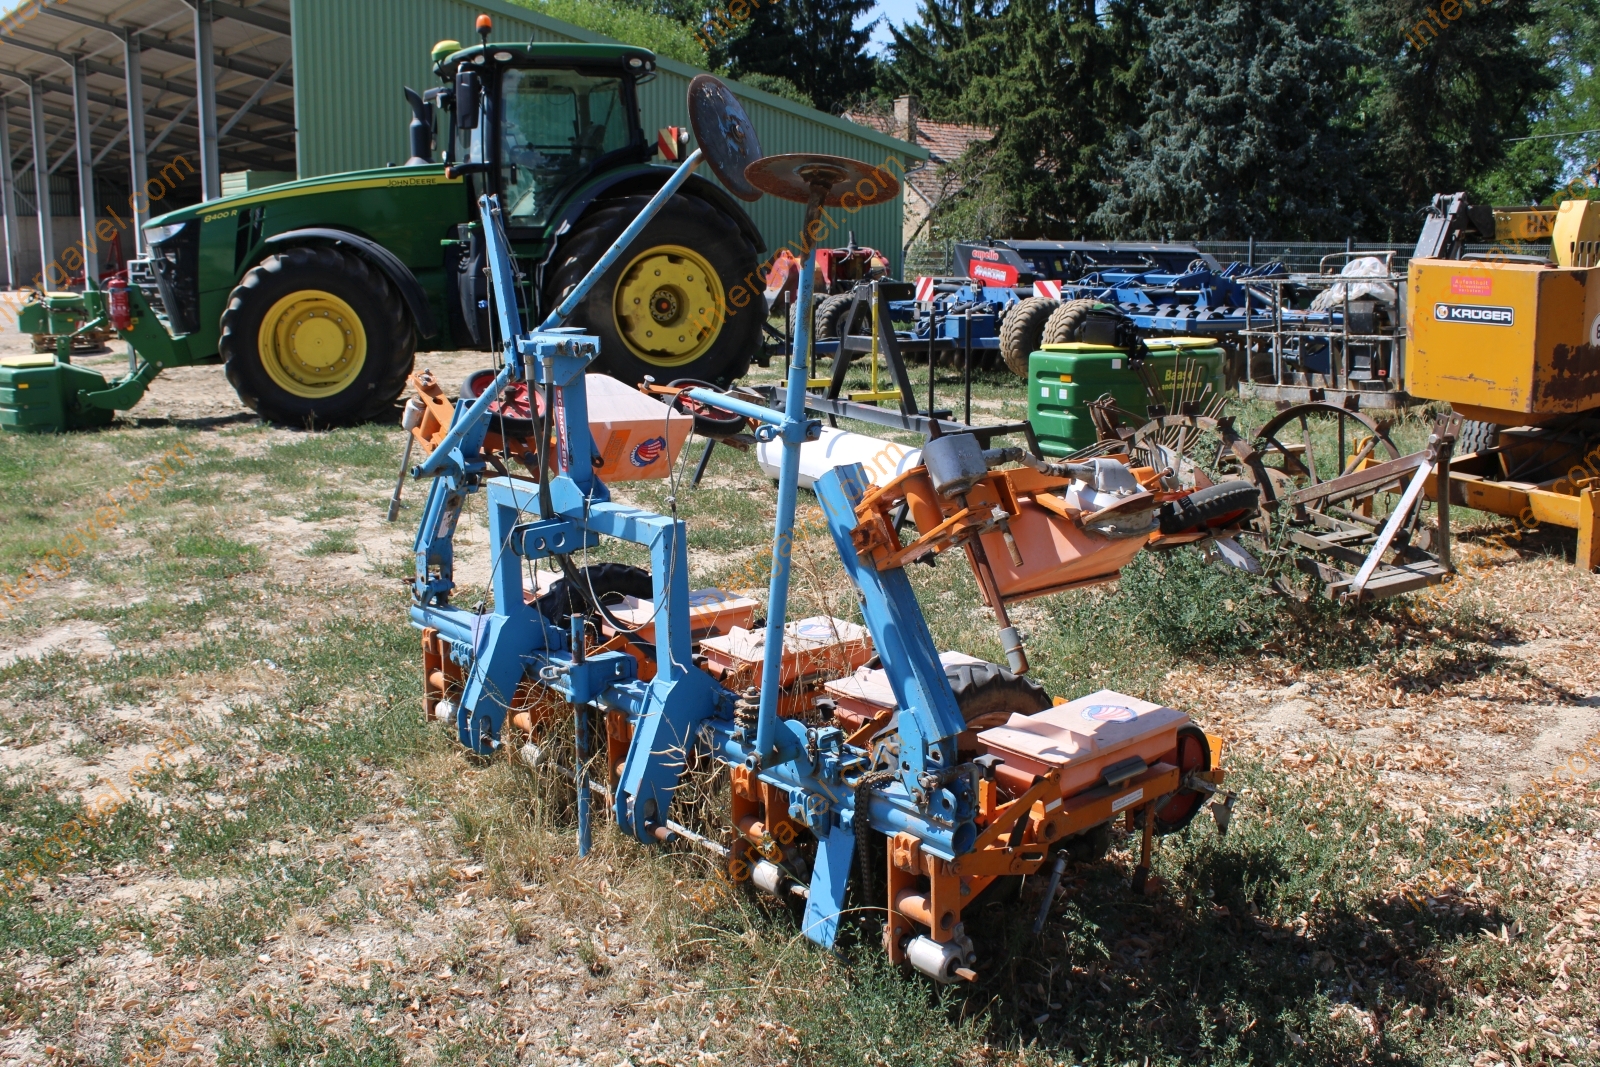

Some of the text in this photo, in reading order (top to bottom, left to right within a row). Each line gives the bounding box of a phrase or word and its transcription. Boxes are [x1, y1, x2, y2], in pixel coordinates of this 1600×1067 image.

[387, 177, 437, 188] JOHN DEERE
[204, 209, 238, 223] 8400 R
[971, 249, 999, 261] capello
[974, 265, 1007, 282] SPARTAN
[1451, 308, 1512, 321] KRÜGER
[1164, 369, 1193, 381] Baase
[557, 389, 568, 469] SCHMOTZER
